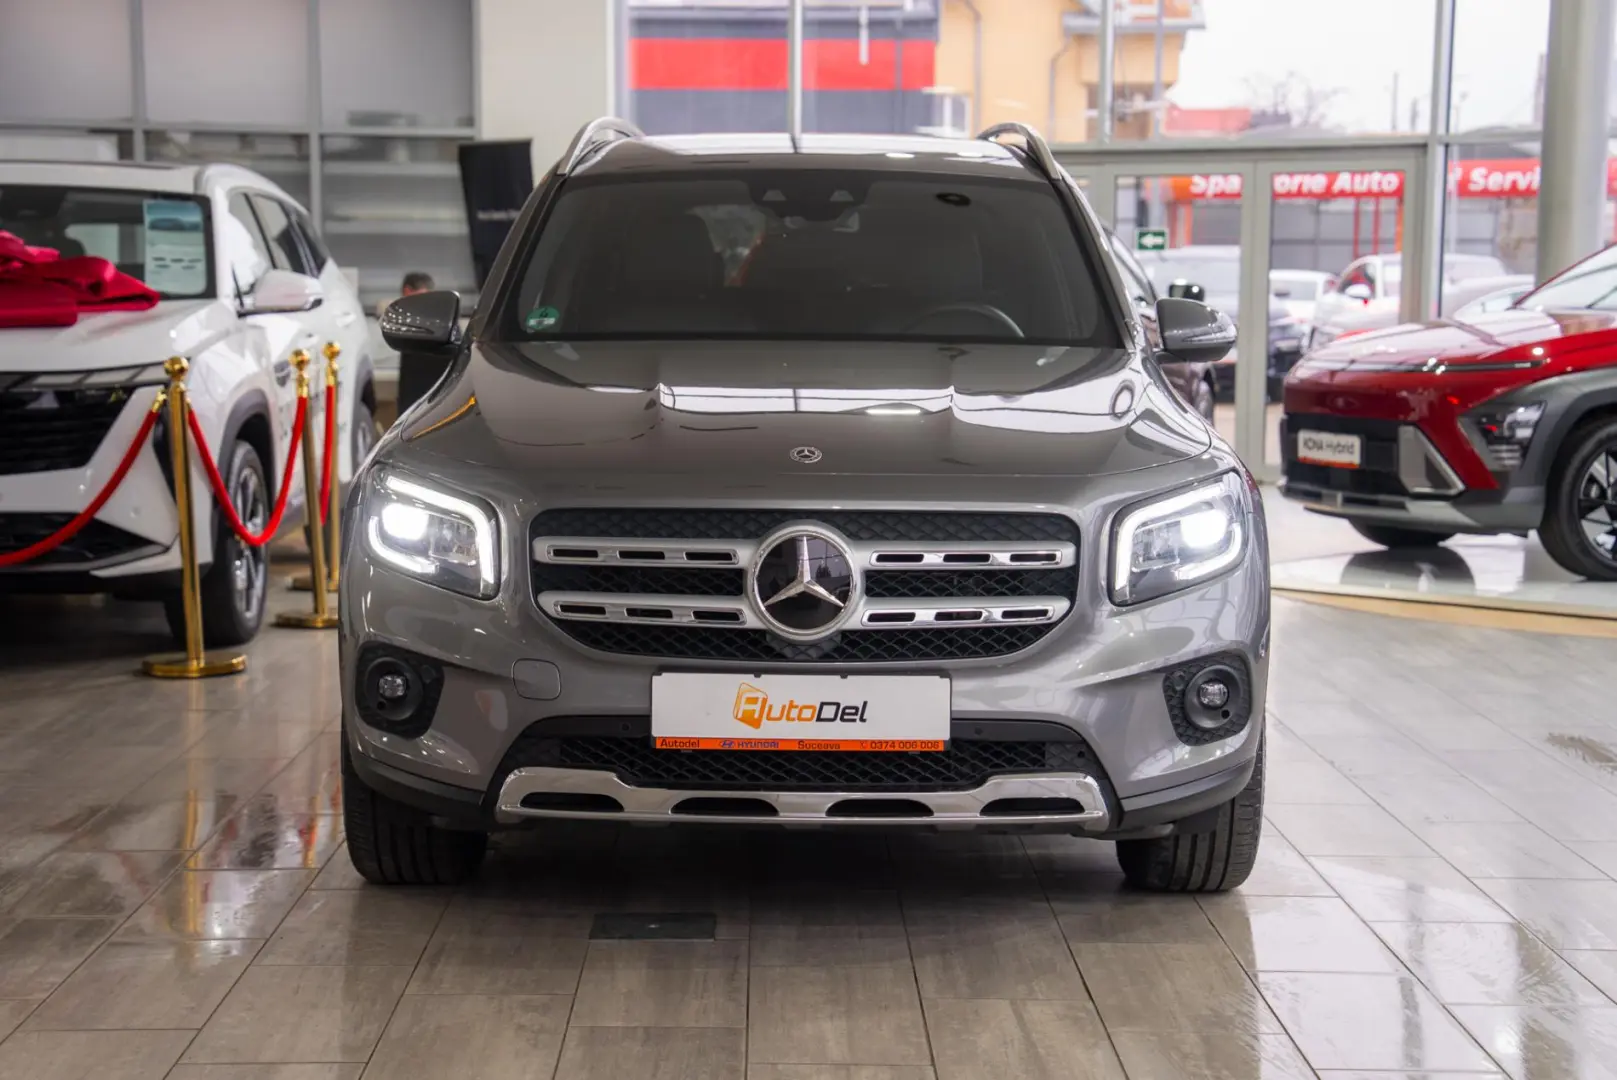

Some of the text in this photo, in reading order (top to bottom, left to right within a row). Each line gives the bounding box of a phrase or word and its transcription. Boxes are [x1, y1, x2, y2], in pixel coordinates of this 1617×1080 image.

[1332, 171, 1399, 193] Auto
[735, 688, 868, 726] AutoDel
[660, 738, 700, 749] Autodel
[737, 741, 779, 749] HYUNDAI
[797, 740, 841, 750] Suceava
[870, 740, 896, 750] 0374
[898, 740, 917, 750] 006
